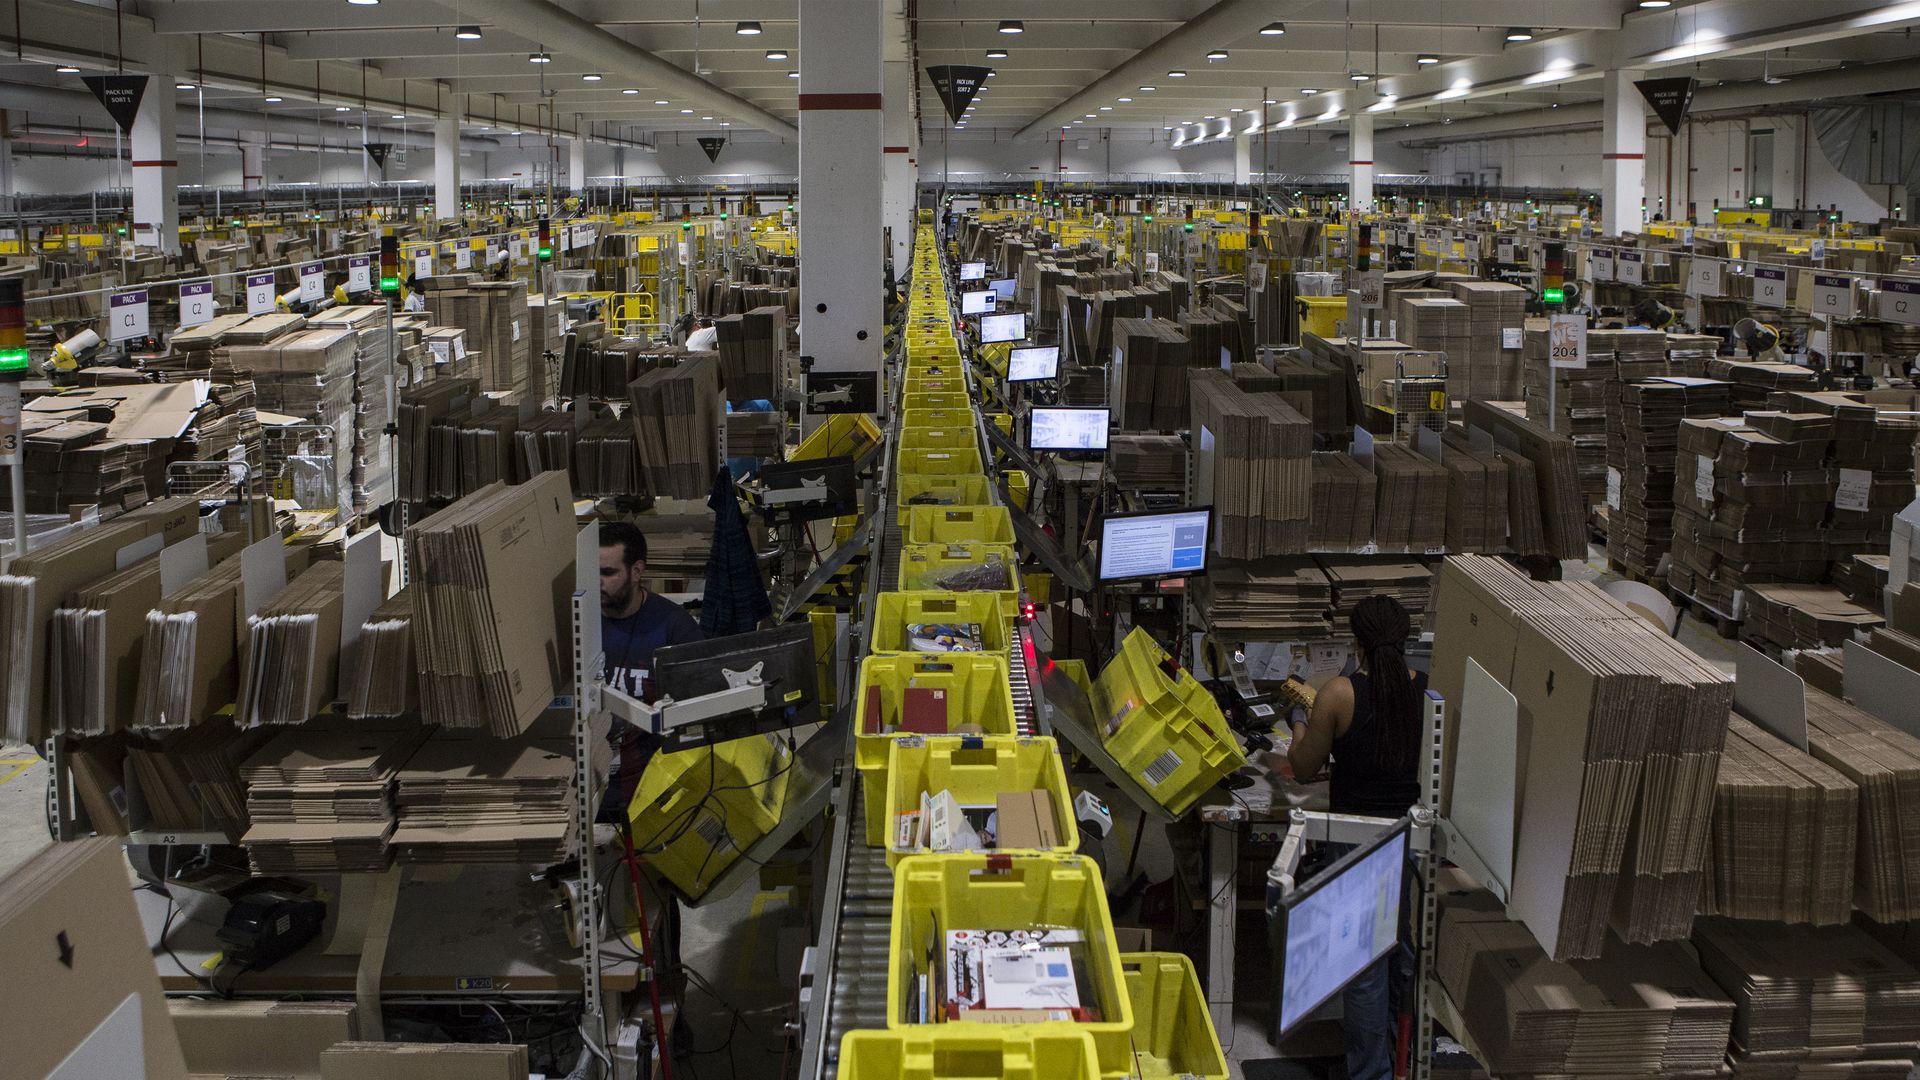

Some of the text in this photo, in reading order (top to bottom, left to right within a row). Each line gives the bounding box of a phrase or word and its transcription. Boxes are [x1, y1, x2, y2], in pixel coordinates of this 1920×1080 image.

[1702, 271, 1711, 281] C5
[190, 285, 203, 294] PACK
[1764, 286, 1774, 296] C4
[1895, 283, 1911, 292] PACK
[122, 294, 137, 304] PACK
[257, 292, 266, 304] C3
[1361, 294, 1379, 302] 206
[1826, 294, 1837, 306] C3
[192, 303, 202, 315] C2
[1895, 300, 1908, 313] C2
[124, 313, 136, 327] C1
[1552, 346, 1579, 358] 204
[163, 835, 176, 843] A2
